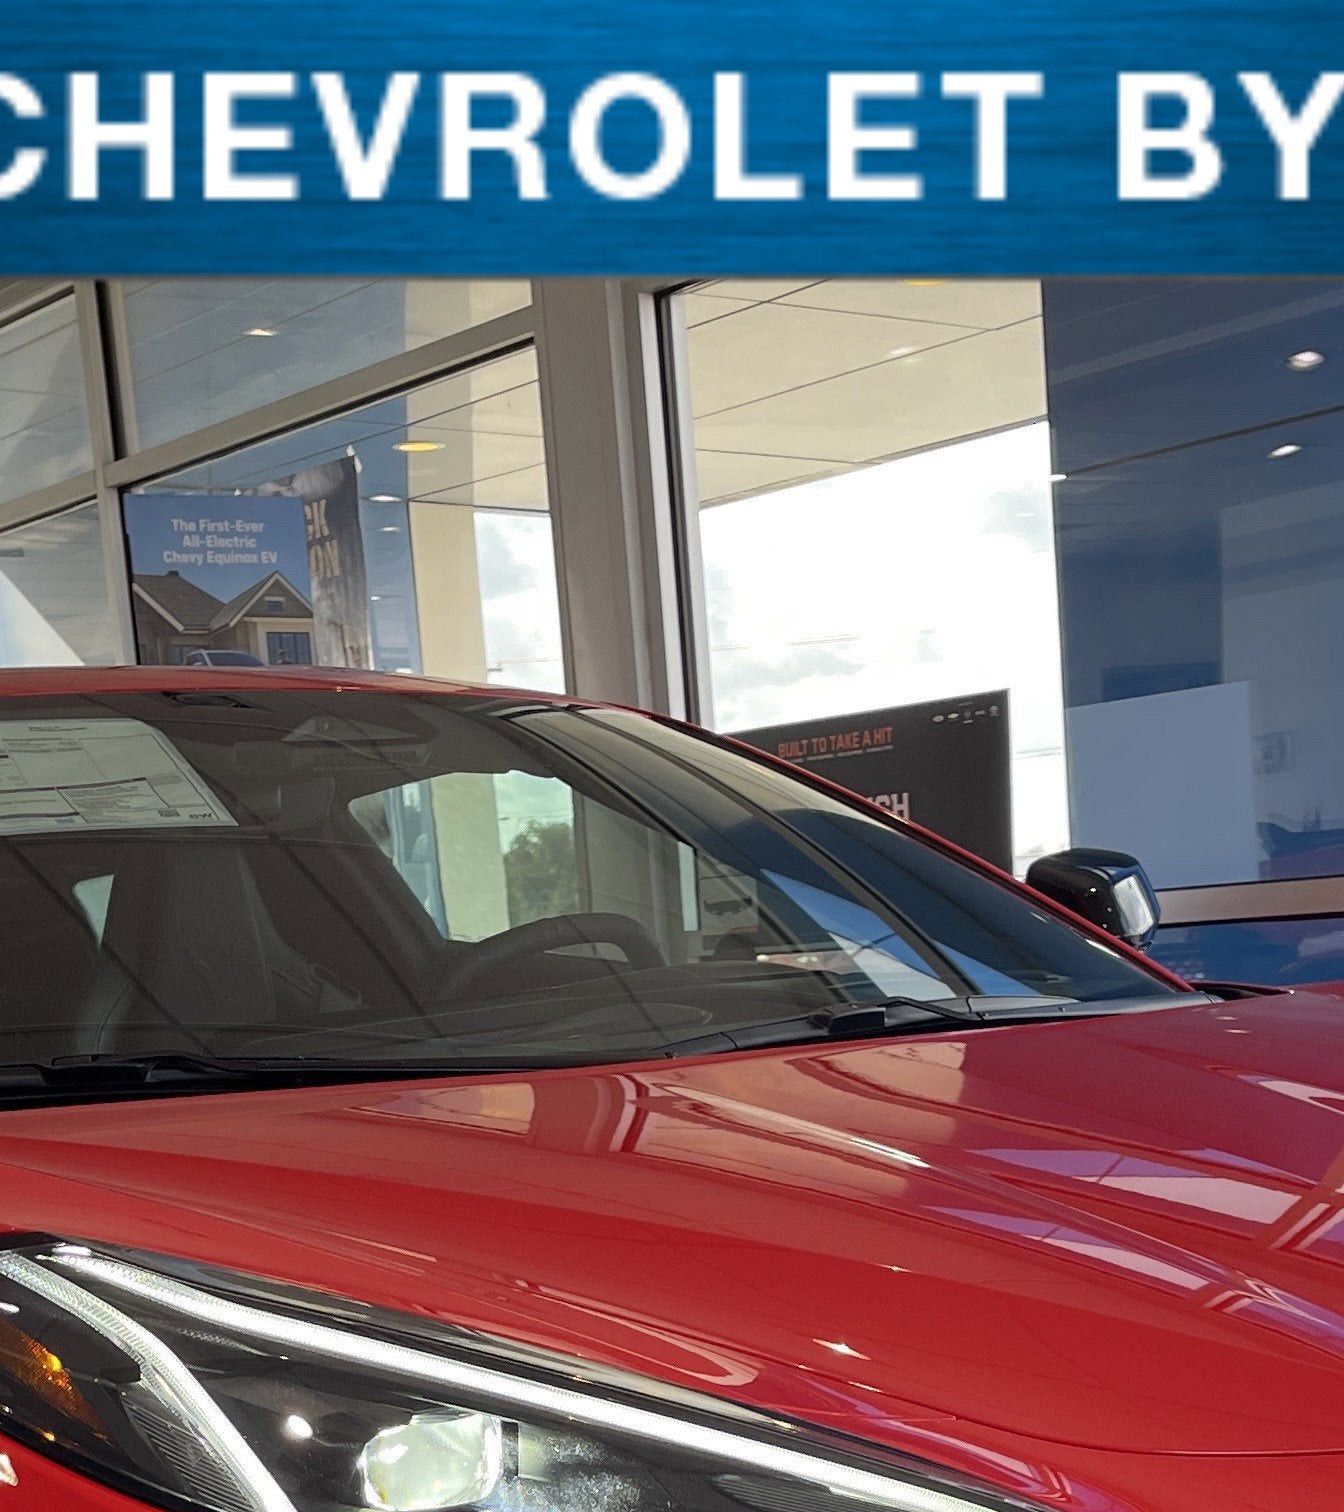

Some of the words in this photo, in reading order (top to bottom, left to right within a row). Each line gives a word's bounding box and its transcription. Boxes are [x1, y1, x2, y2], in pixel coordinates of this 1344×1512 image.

[170, 518, 197, 533] The
[199, 518, 266, 533] First-Ever
[182, 534, 257, 549] All-Electric
[163, 550, 204, 566] Chevy
[206, 550, 258, 566] Equinox
[260, 550, 279, 565] EV
[778, 739, 808, 759] BUILT
[811, 736, 827, 753] TO
[829, 731, 861, 751] TAKE
[862, 730, 874, 747] A
[873, 726, 893, 745] HIT
